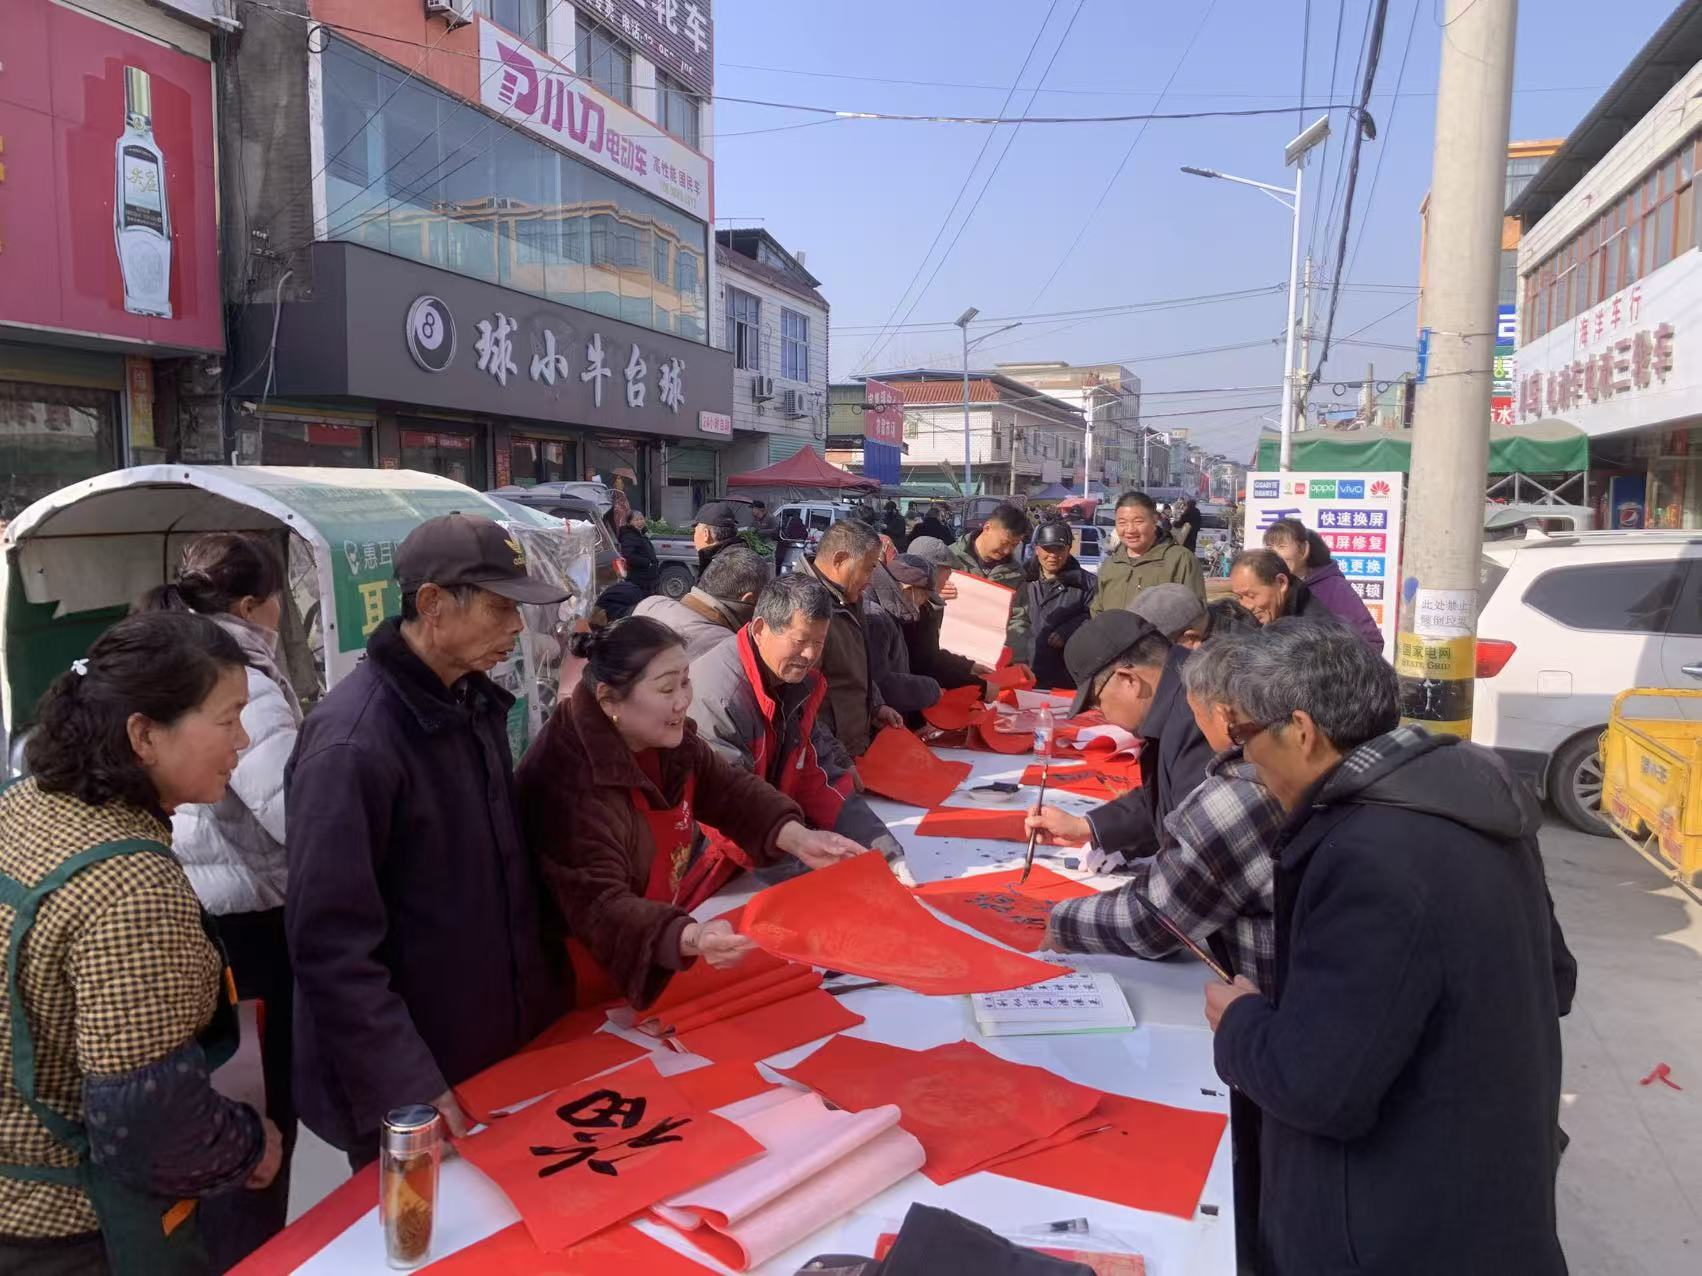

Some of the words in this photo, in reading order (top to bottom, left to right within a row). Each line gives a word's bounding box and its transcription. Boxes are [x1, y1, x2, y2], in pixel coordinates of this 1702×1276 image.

[473, 312, 686, 414] 球小牛台球
[1341, 484, 1364, 494] vivo
[1321, 511, 1384, 526] 快速换屏
[1402, 644, 1451, 660] 国家电网
[1427, 661, 1451, 670] GRID
